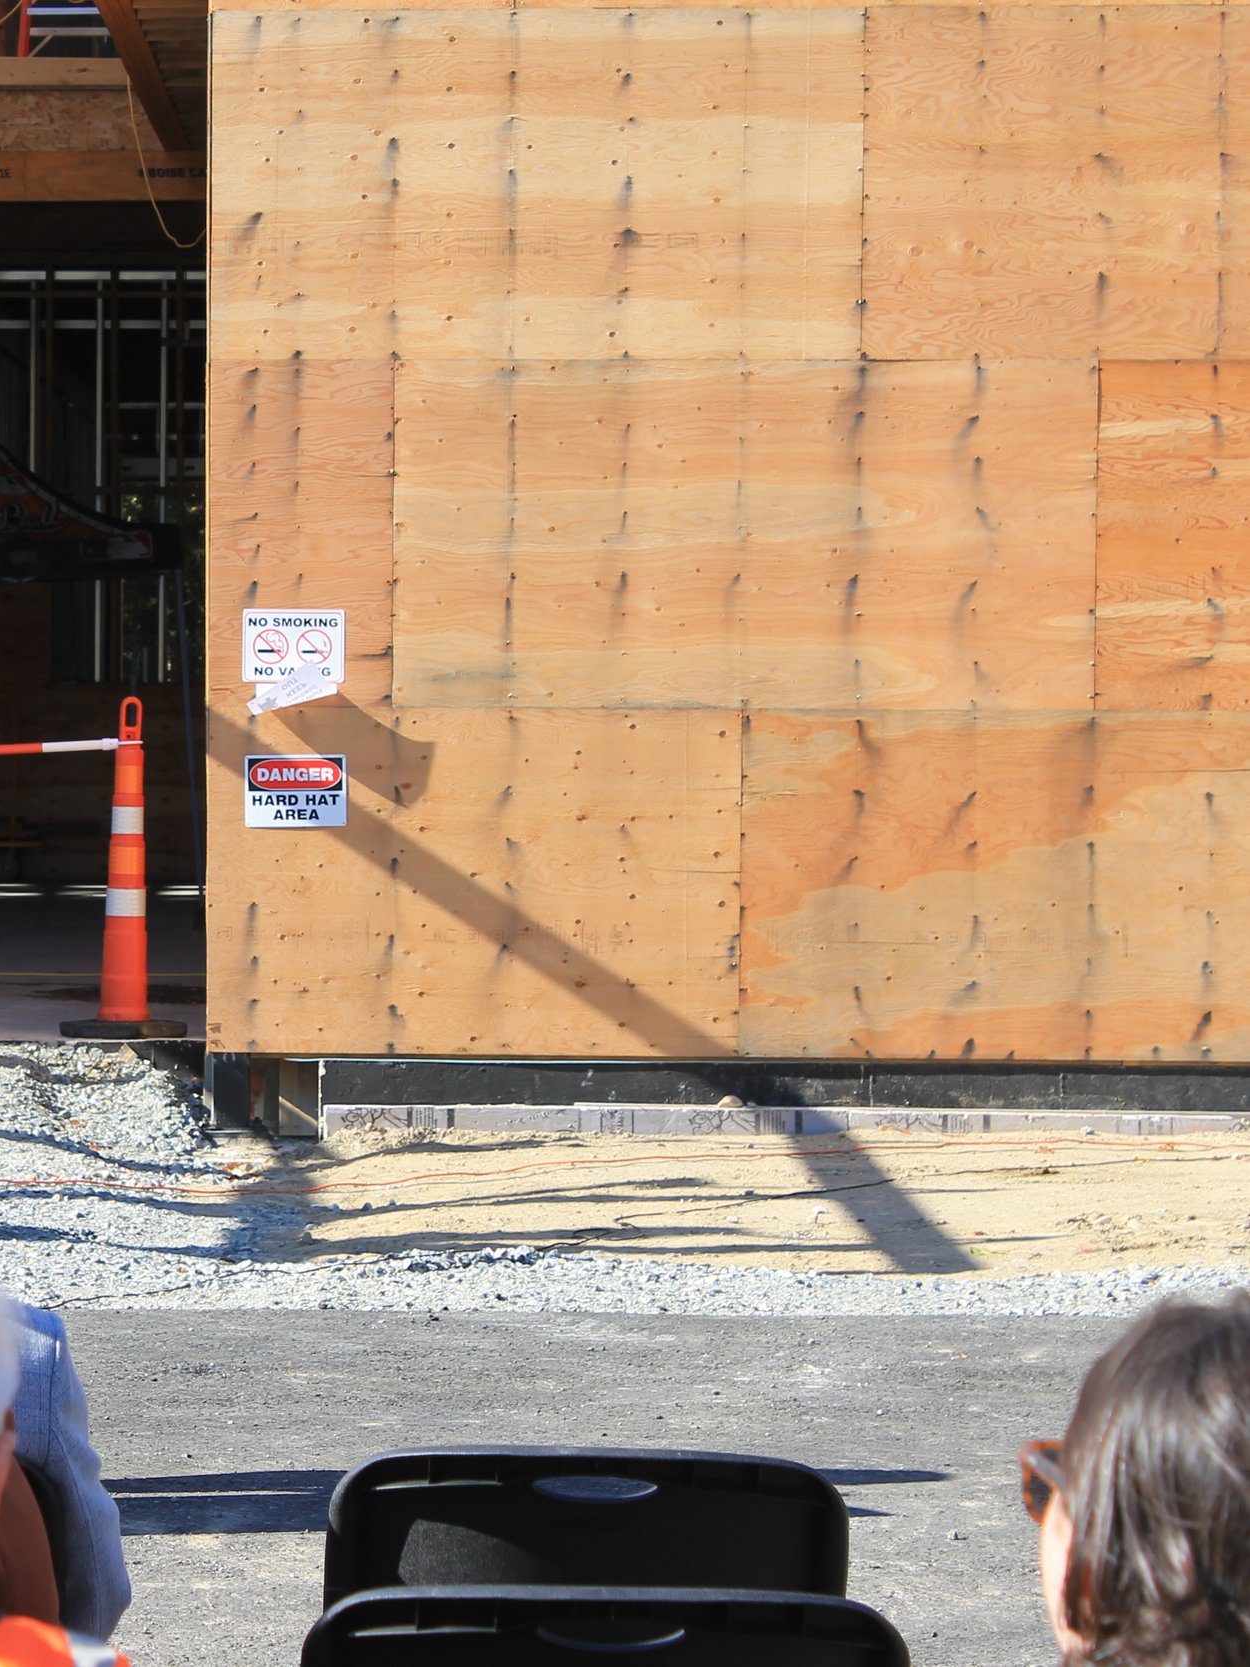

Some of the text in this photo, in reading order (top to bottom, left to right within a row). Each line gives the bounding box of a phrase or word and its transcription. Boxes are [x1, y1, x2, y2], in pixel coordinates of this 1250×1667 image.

[248, 617, 338, 628] NO SMOKING
[254, 666, 274, 676] NO
[257, 767, 334, 782] DANGER
[252, 794, 340, 806] HARD HAT
[273, 809, 319, 820] AREA
